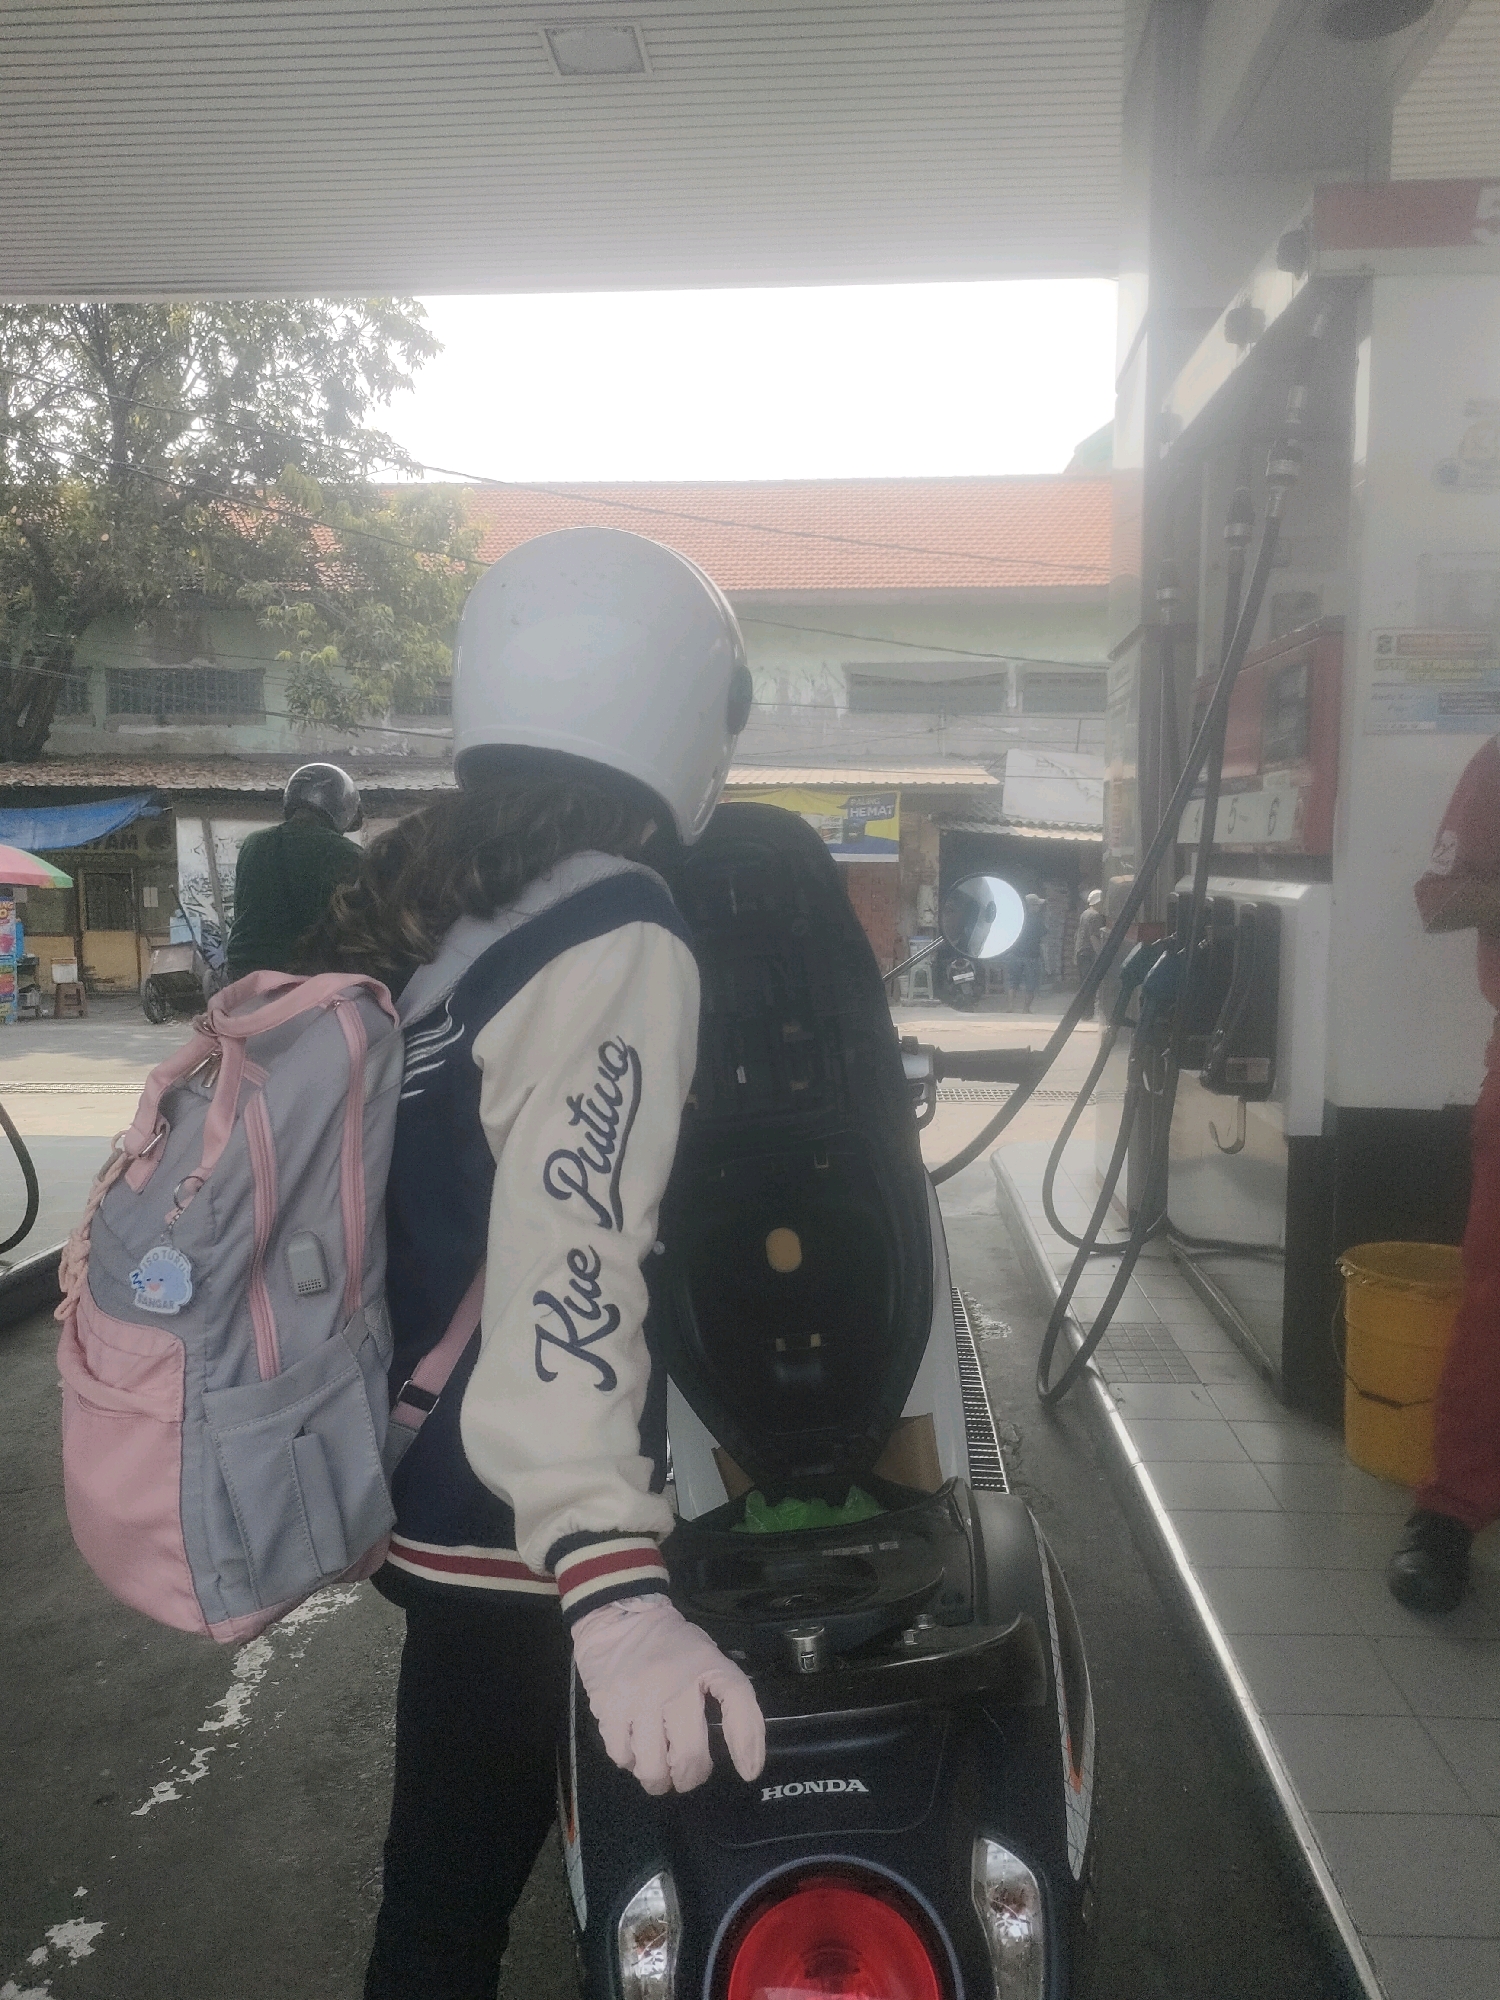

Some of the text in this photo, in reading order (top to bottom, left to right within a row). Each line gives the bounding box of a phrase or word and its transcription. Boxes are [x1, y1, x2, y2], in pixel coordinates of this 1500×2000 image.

[850, 798, 880, 806] PALING
[850, 805, 895, 818] HEMAT
[532, 1244, 621, 1392] Kue
[761, 1779, 869, 1801] HONDA
